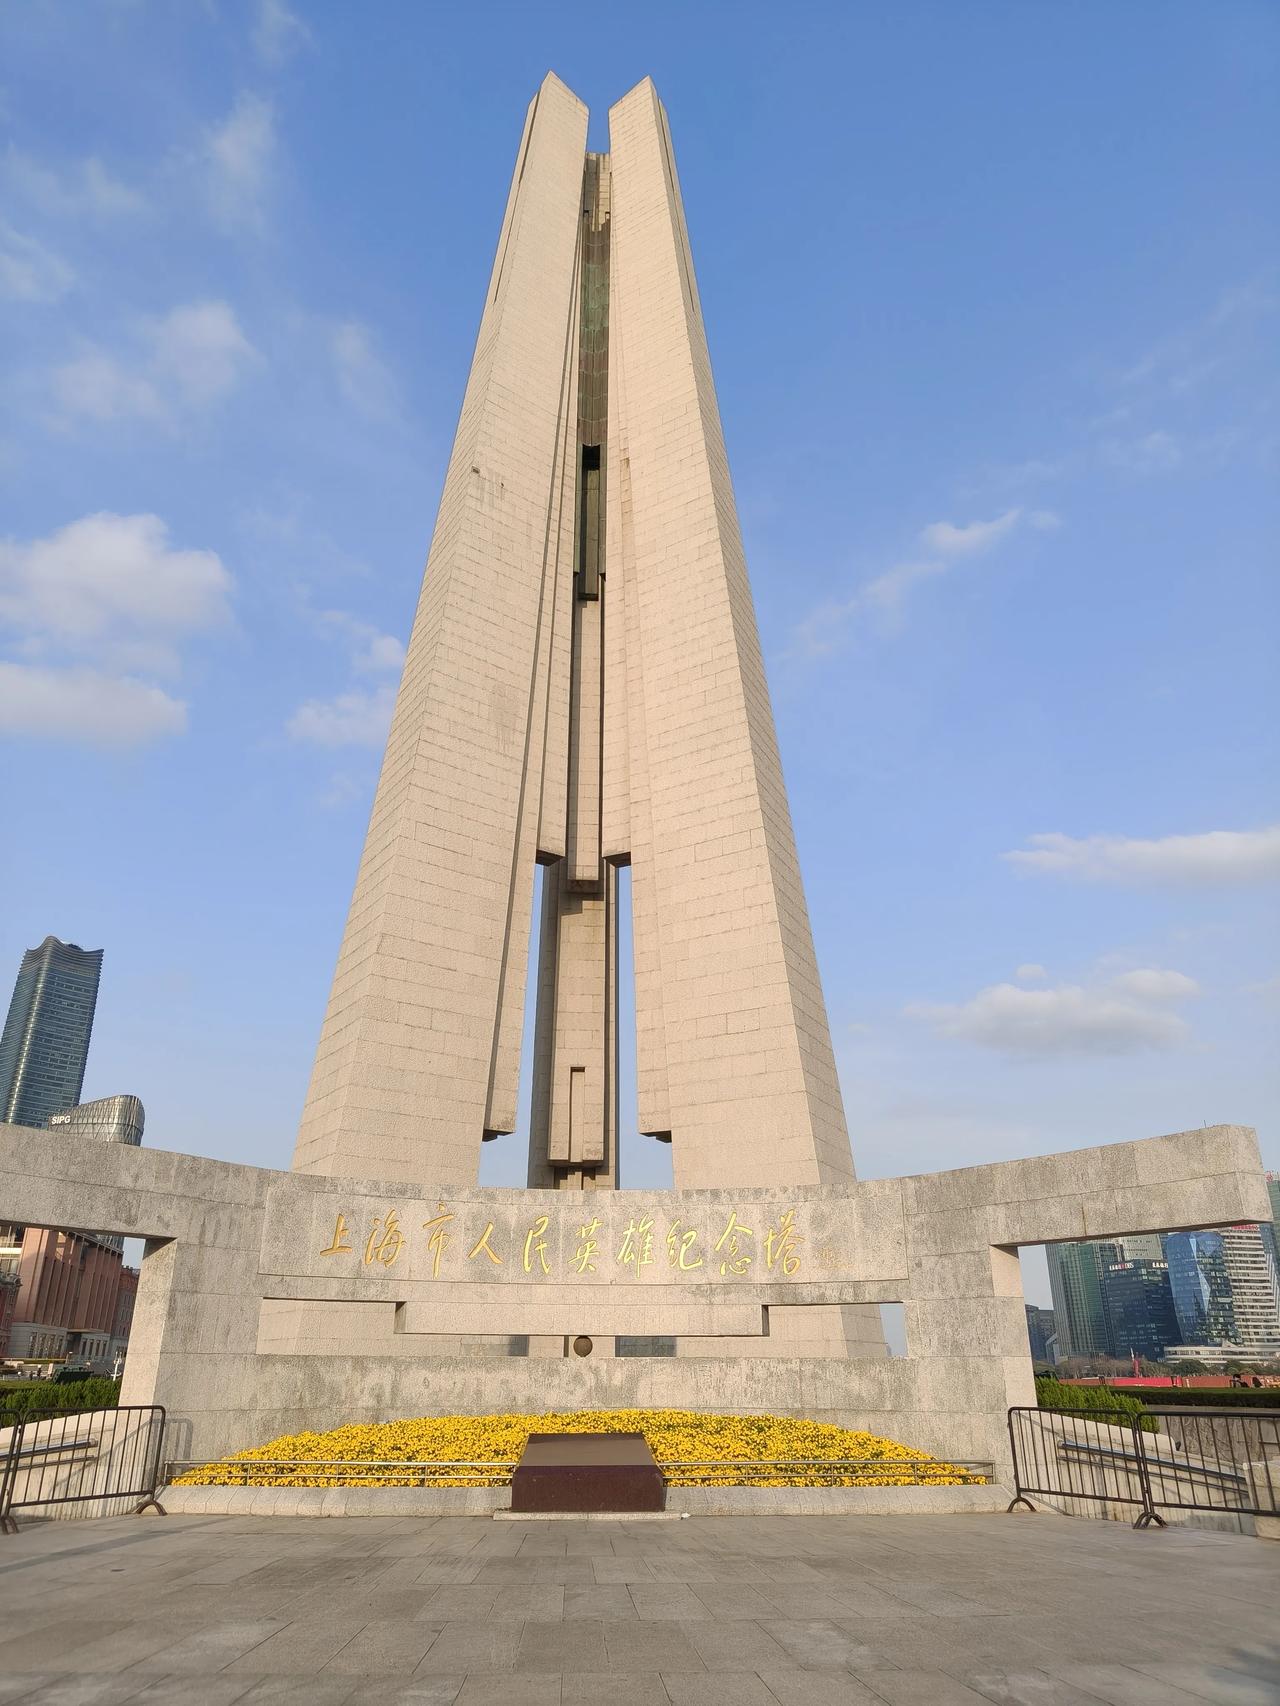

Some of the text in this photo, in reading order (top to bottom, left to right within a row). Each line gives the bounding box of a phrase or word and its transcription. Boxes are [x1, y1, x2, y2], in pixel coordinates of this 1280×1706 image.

[51, 1115, 71, 1124] SIPG
[320, 1202, 804, 1280] 上海市人民英雄纪念塔
